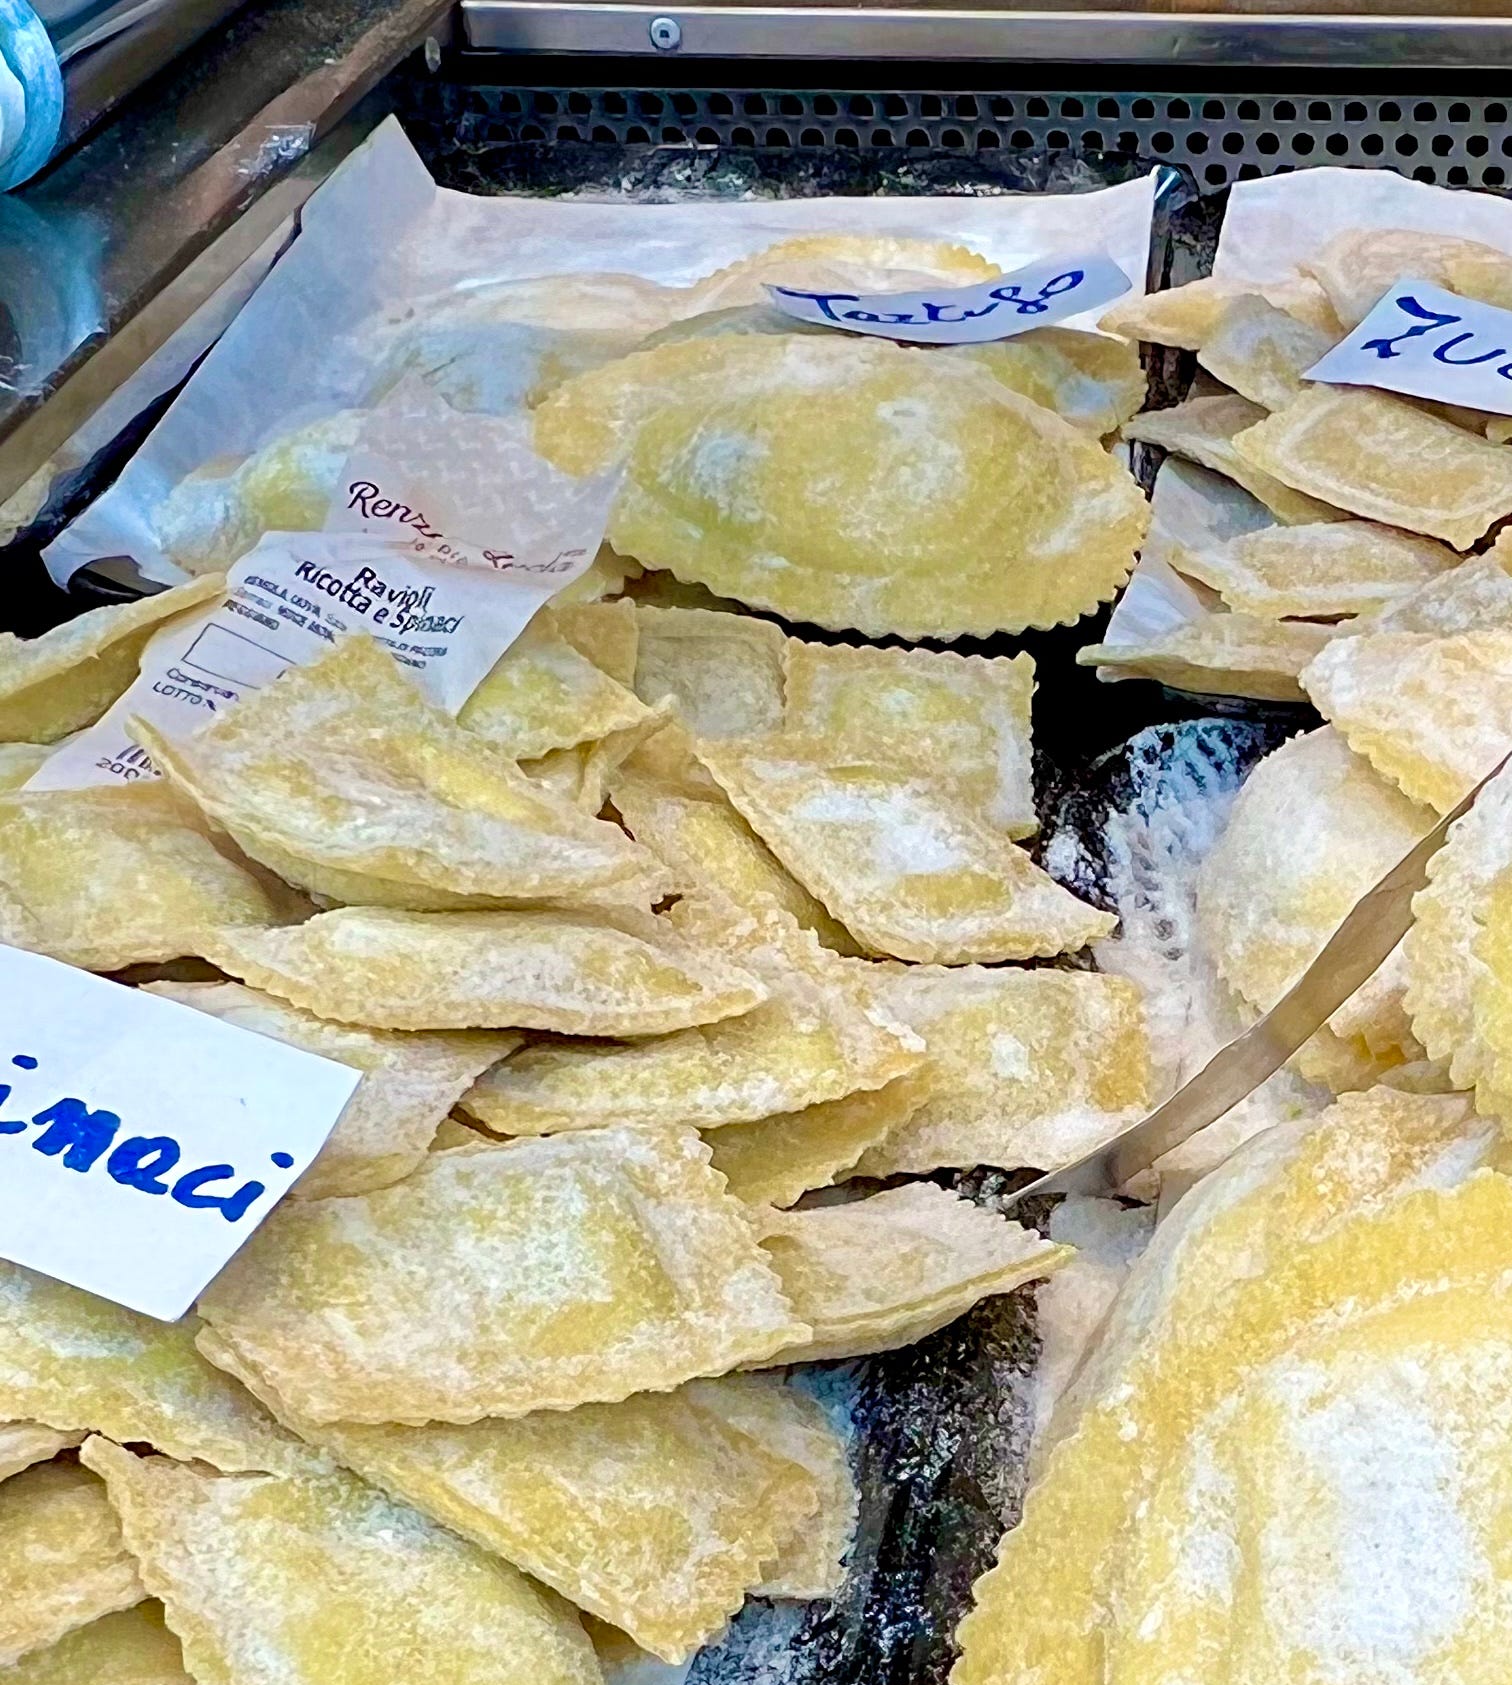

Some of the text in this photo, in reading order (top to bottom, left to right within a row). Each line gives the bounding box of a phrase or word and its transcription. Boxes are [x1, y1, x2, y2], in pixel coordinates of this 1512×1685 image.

[295, 560, 372, 615] Ricotta
[373, 606, 390, 625] e
[353, 566, 437, 610] Ravioli
